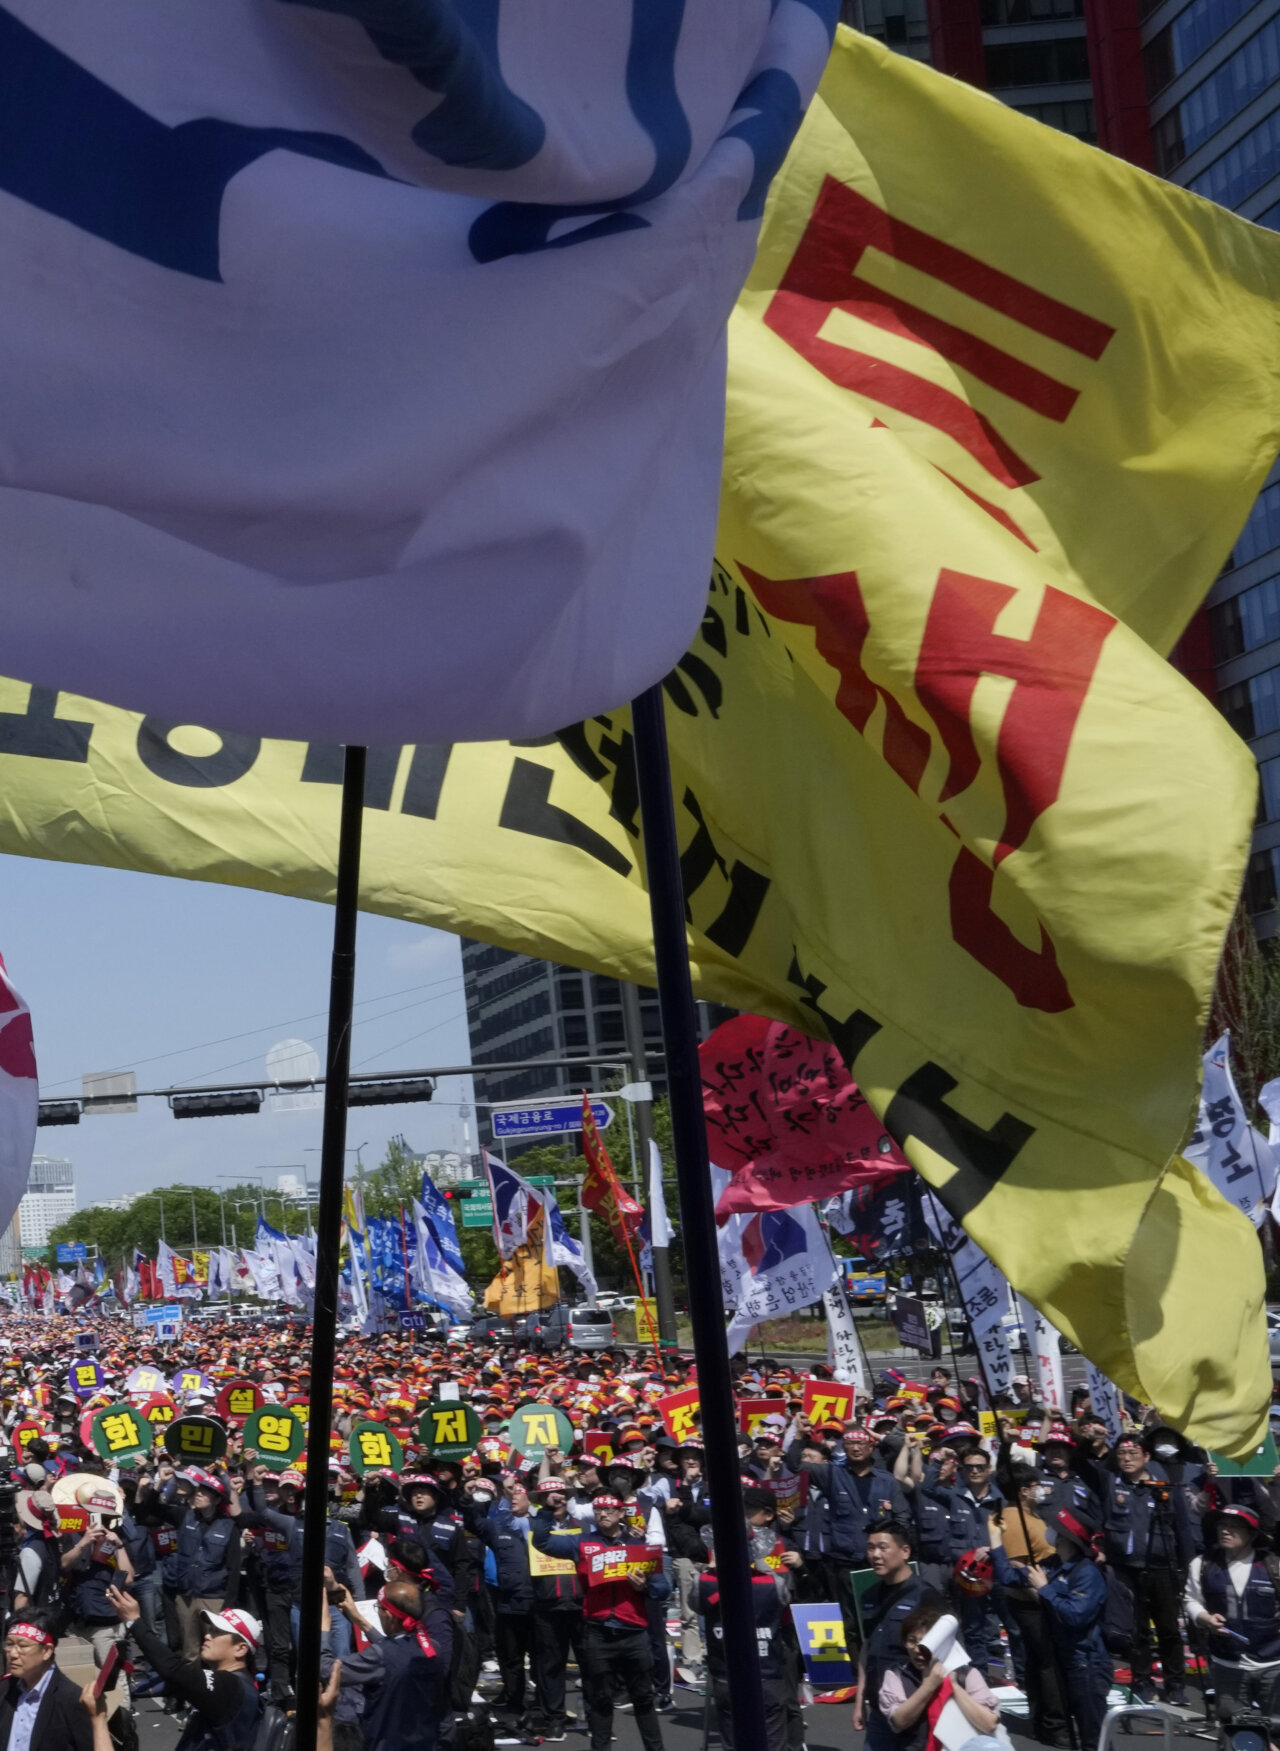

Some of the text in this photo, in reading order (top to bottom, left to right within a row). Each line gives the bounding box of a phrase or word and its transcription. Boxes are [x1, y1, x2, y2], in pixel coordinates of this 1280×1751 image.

[496, 1110, 554, 1126] 국제금융로
[75, 1362, 97, 1387] 편
[135, 1370, 158, 1391] 저
[181, 1373, 202, 1391] 지
[148, 1405, 174, 1422] 사
[228, 1387, 255, 1415] 설
[101, 1411, 141, 1452] 화
[180, 1424, 214, 1454] 민
[258, 1415, 293, 1452] 영
[432, 1409, 468, 1444] 저
[522, 1413, 560, 1446] 지
[358, 1432, 393, 1467] 화
[591, 1551, 627, 1574] 멈춰라
